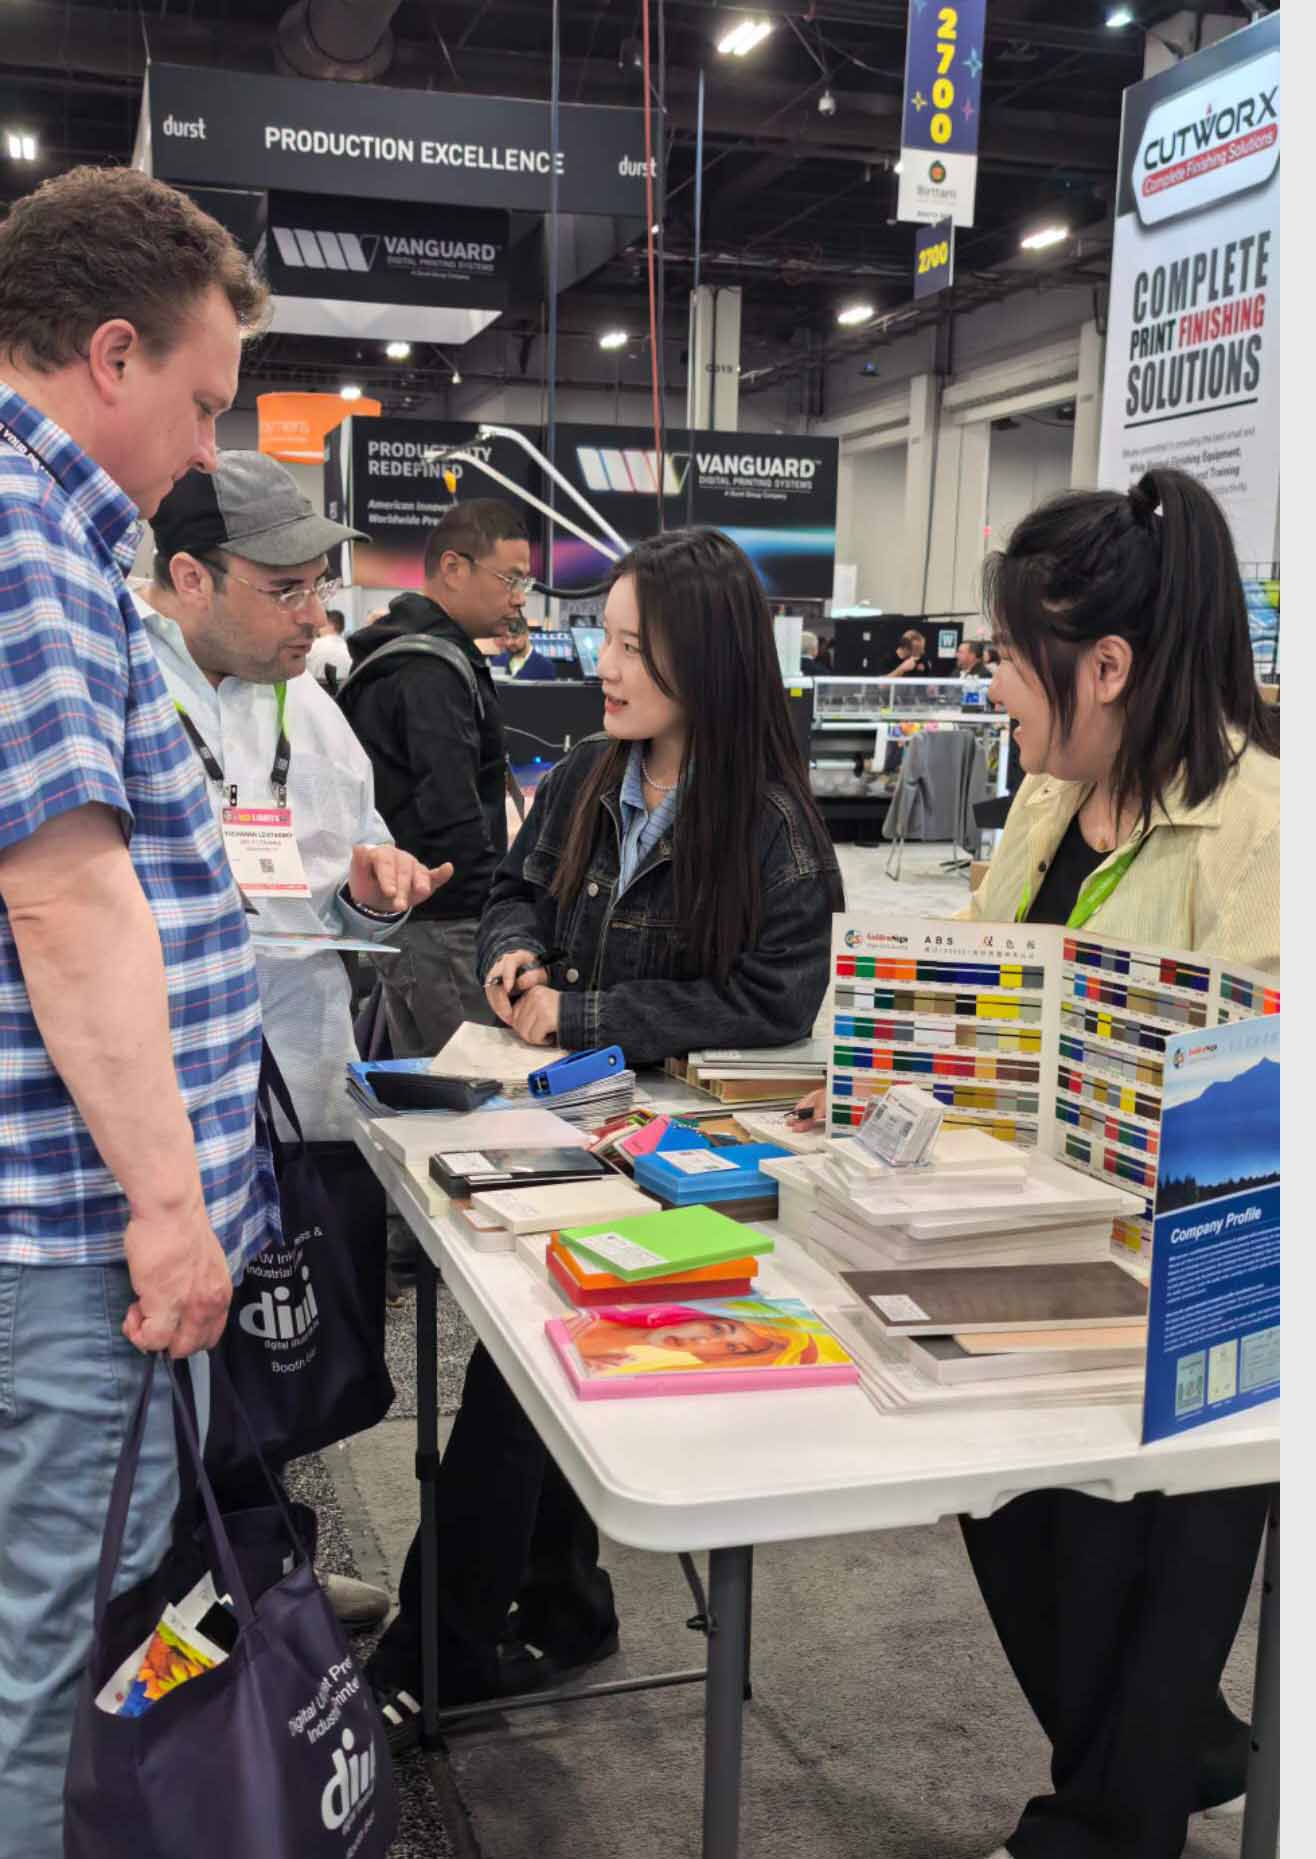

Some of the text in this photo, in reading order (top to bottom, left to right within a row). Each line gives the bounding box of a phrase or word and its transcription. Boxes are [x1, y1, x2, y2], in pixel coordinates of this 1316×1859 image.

[930, 8, 958, 144] 2700
[163, 115, 206, 140] durst
[1144, 86, 1278, 170] CUTWORX
[1228, 131, 1273, 160] Solutions
[264, 126, 565, 174] PRODUCTION EXCELLENCE
[618, 155, 657, 177] durst
[384, 235, 496, 261] VANGUARD
[1133, 230, 1271, 324] COMPLETE
[1130, 293, 1265, 361] PRINT FINISHING
[1126, 334, 1262, 416] SOLUTIONS
[696, 453, 816, 478] VANGUARD
[368, 499, 415, 511] American
[1170, 1206, 1262, 1244] Company Profile
